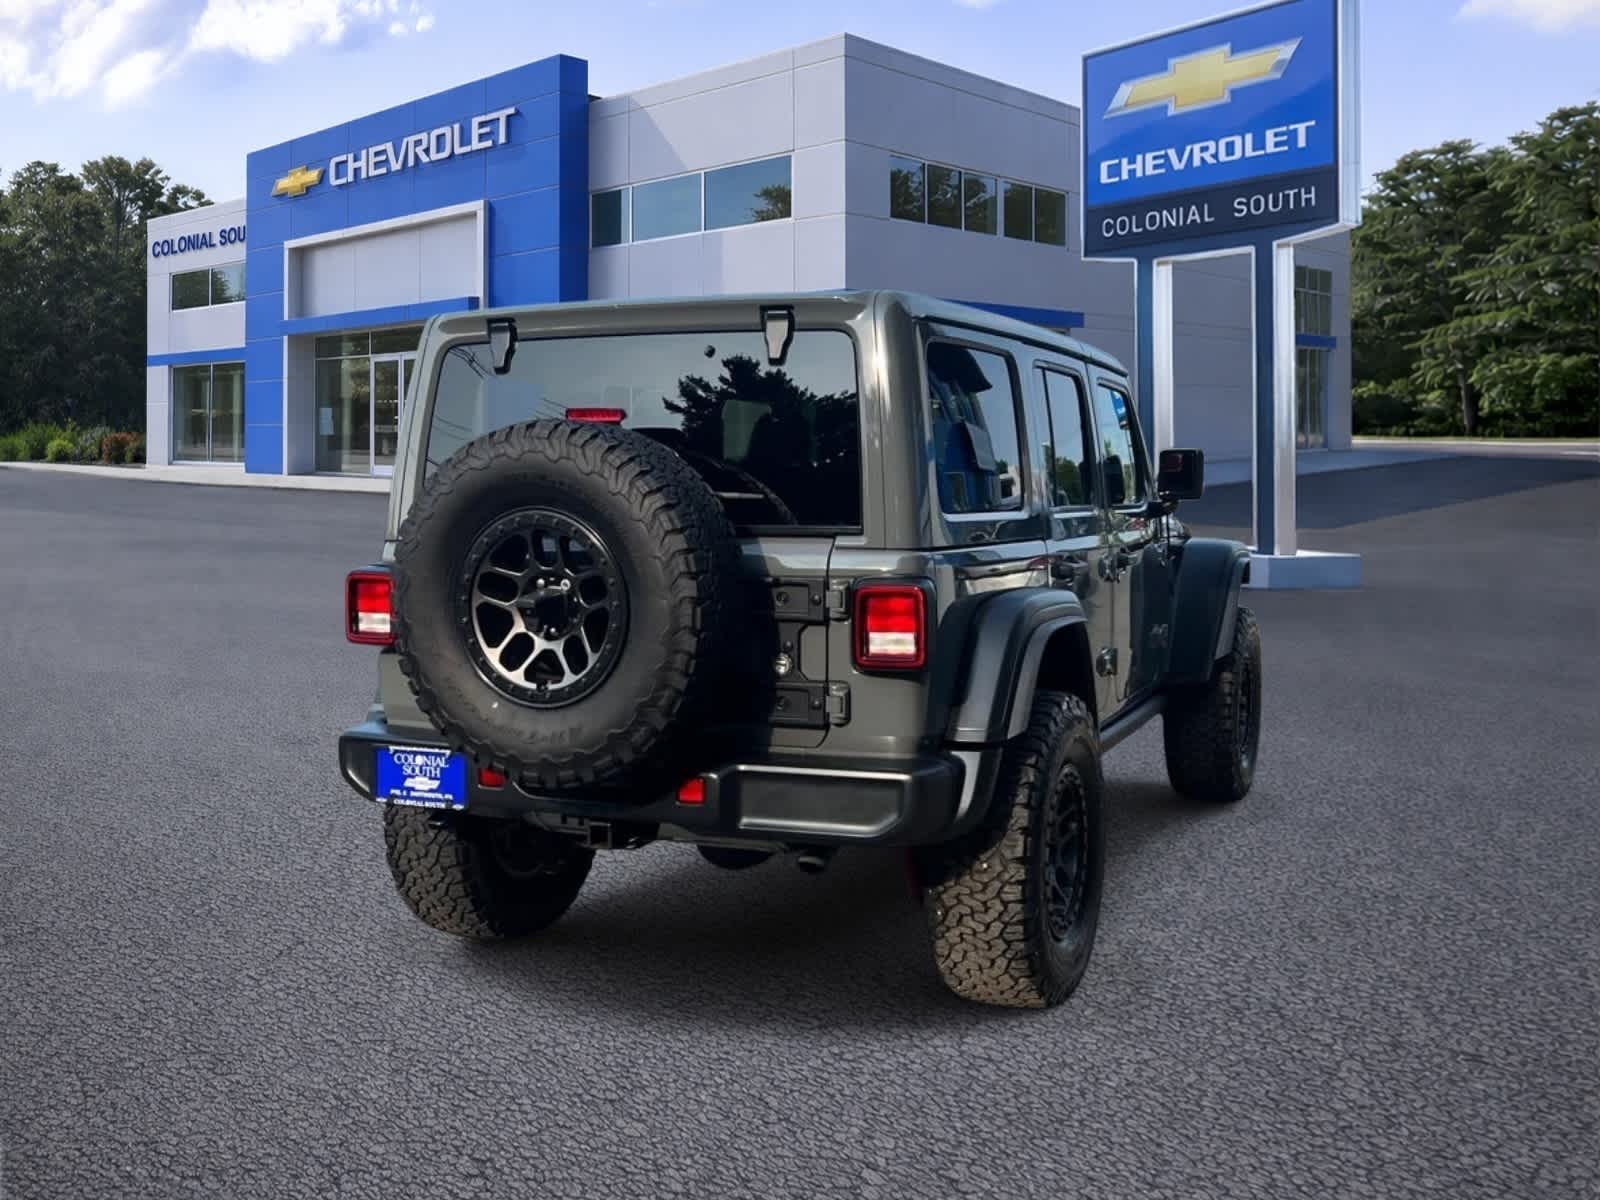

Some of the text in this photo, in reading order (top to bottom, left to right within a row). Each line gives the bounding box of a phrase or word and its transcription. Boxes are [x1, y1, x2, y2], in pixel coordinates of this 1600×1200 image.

[329, 107, 516, 186] CHEVROLET
[1100, 120, 1316, 184] CHEVROLET
[1102, 186, 1316, 237] COLONIAL SOUTH
[152, 225, 246, 258] COLONIAL SOU
[394, 753, 448, 767] COLONIAL
[402, 765, 440, 777] SOUTH
